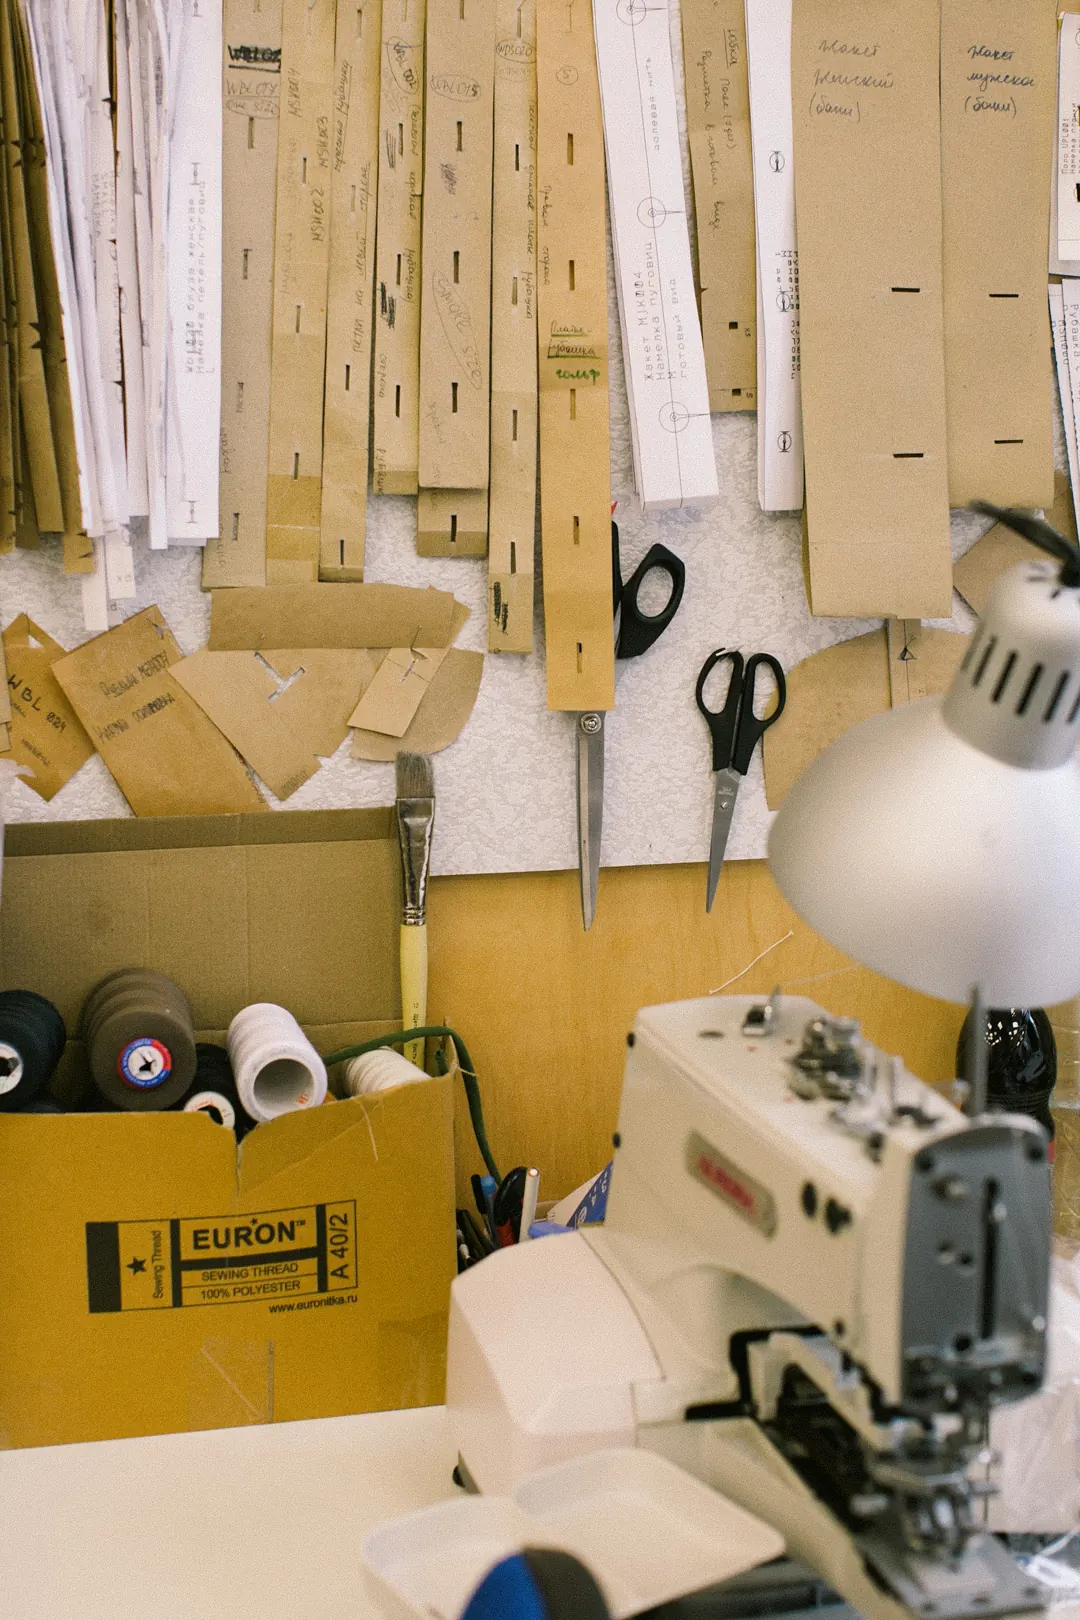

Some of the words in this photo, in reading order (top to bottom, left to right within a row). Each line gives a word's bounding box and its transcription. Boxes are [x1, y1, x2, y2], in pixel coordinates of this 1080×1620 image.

[818, 39, 881, 57] Жакет
[966, 44, 1016, 61] Жакет
[813, 69, 894, 88] Женский
[1061, 153, 1069, 174] Поло
[643, 241, 658, 306] пуговиц
[669, 278, 679, 304] вид
[1069, 303, 1079, 358] Рубашка
[642, 336, 654, 382] Жакет
[652, 316, 666, 381] Намелка
[672, 314, 687, 379] готовый
[151, 1229, 162, 1264] Thread
[329, 1212, 349, 1260] 40/2
[152, 1265, 165, 1299] Sewing
[201, 1267, 249, 1283] SEWING
[252, 1262, 299, 1278] THREAD
[329, 1263, 349, 1280] A
[200, 1287, 230, 1300] 100%
[232, 1280, 301, 1297] POLYESTER
[268, 1294, 358, 1314] www.euronitka.ru
